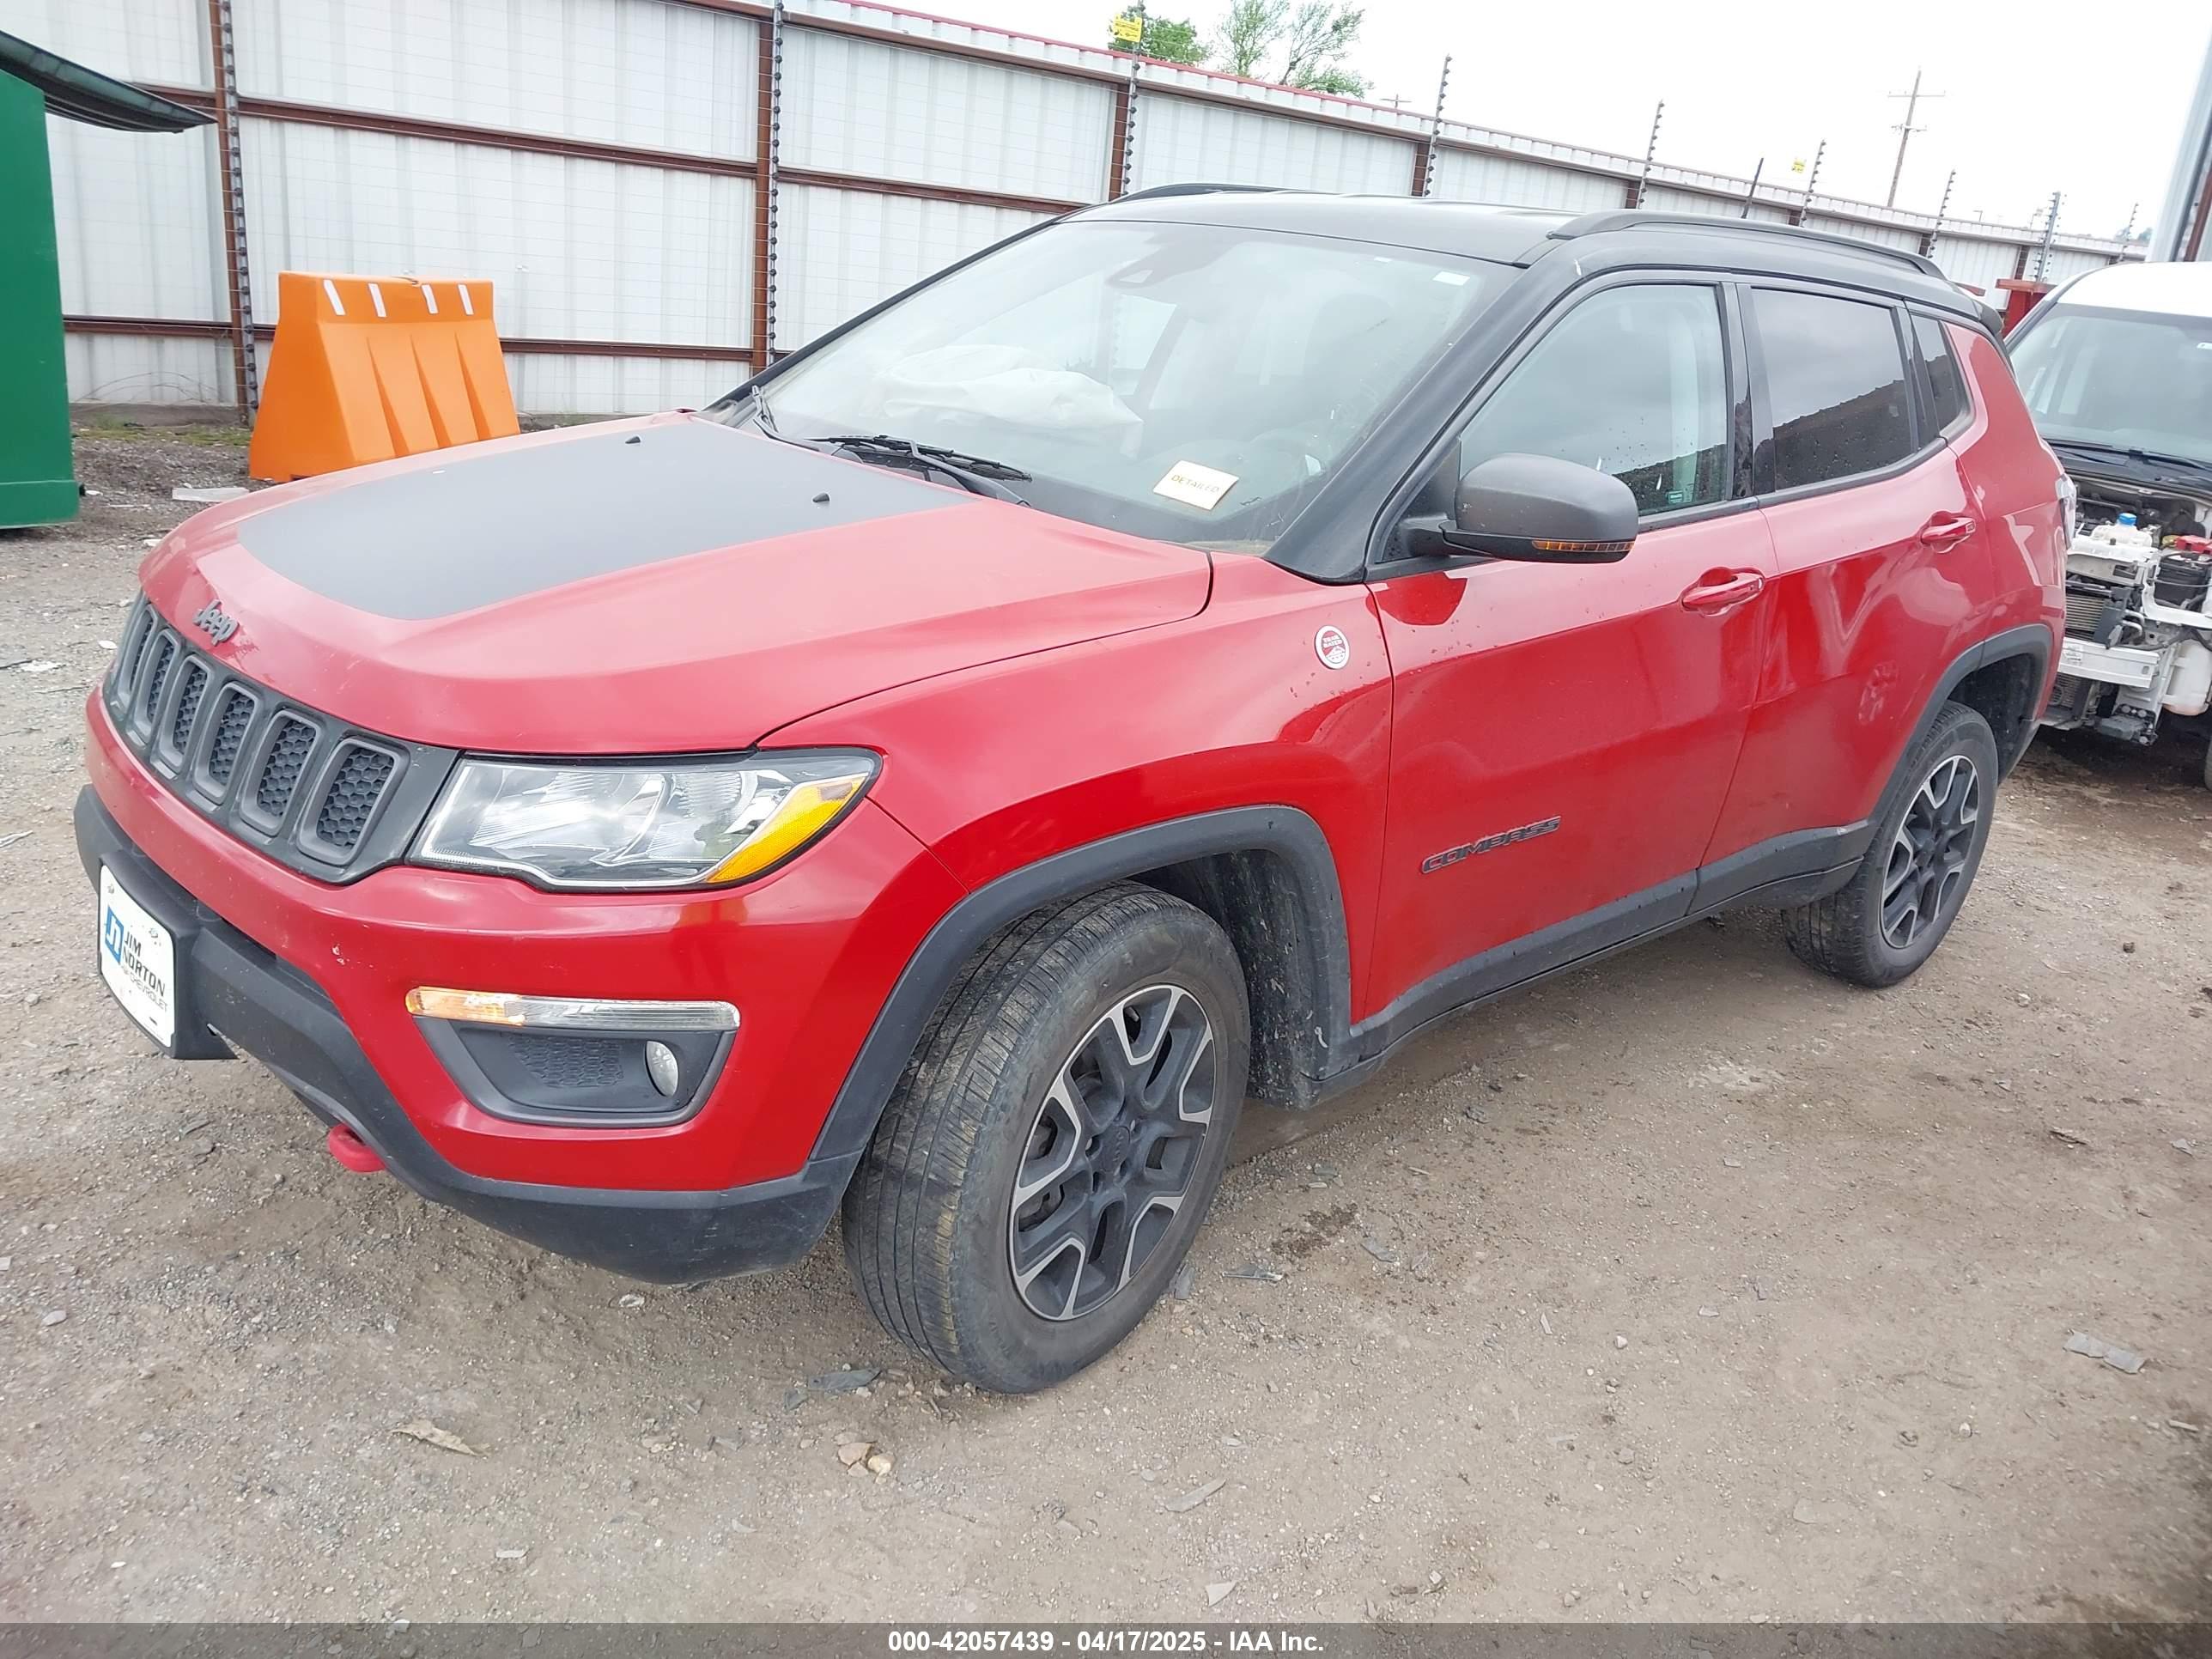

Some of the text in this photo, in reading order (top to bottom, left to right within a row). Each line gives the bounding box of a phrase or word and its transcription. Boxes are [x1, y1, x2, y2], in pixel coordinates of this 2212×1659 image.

[191, 599, 240, 646] Jeep
[1422, 816, 1561, 873] COMPASS
[124, 931, 142, 957] JIM
[122, 945, 166, 997] NORTON
